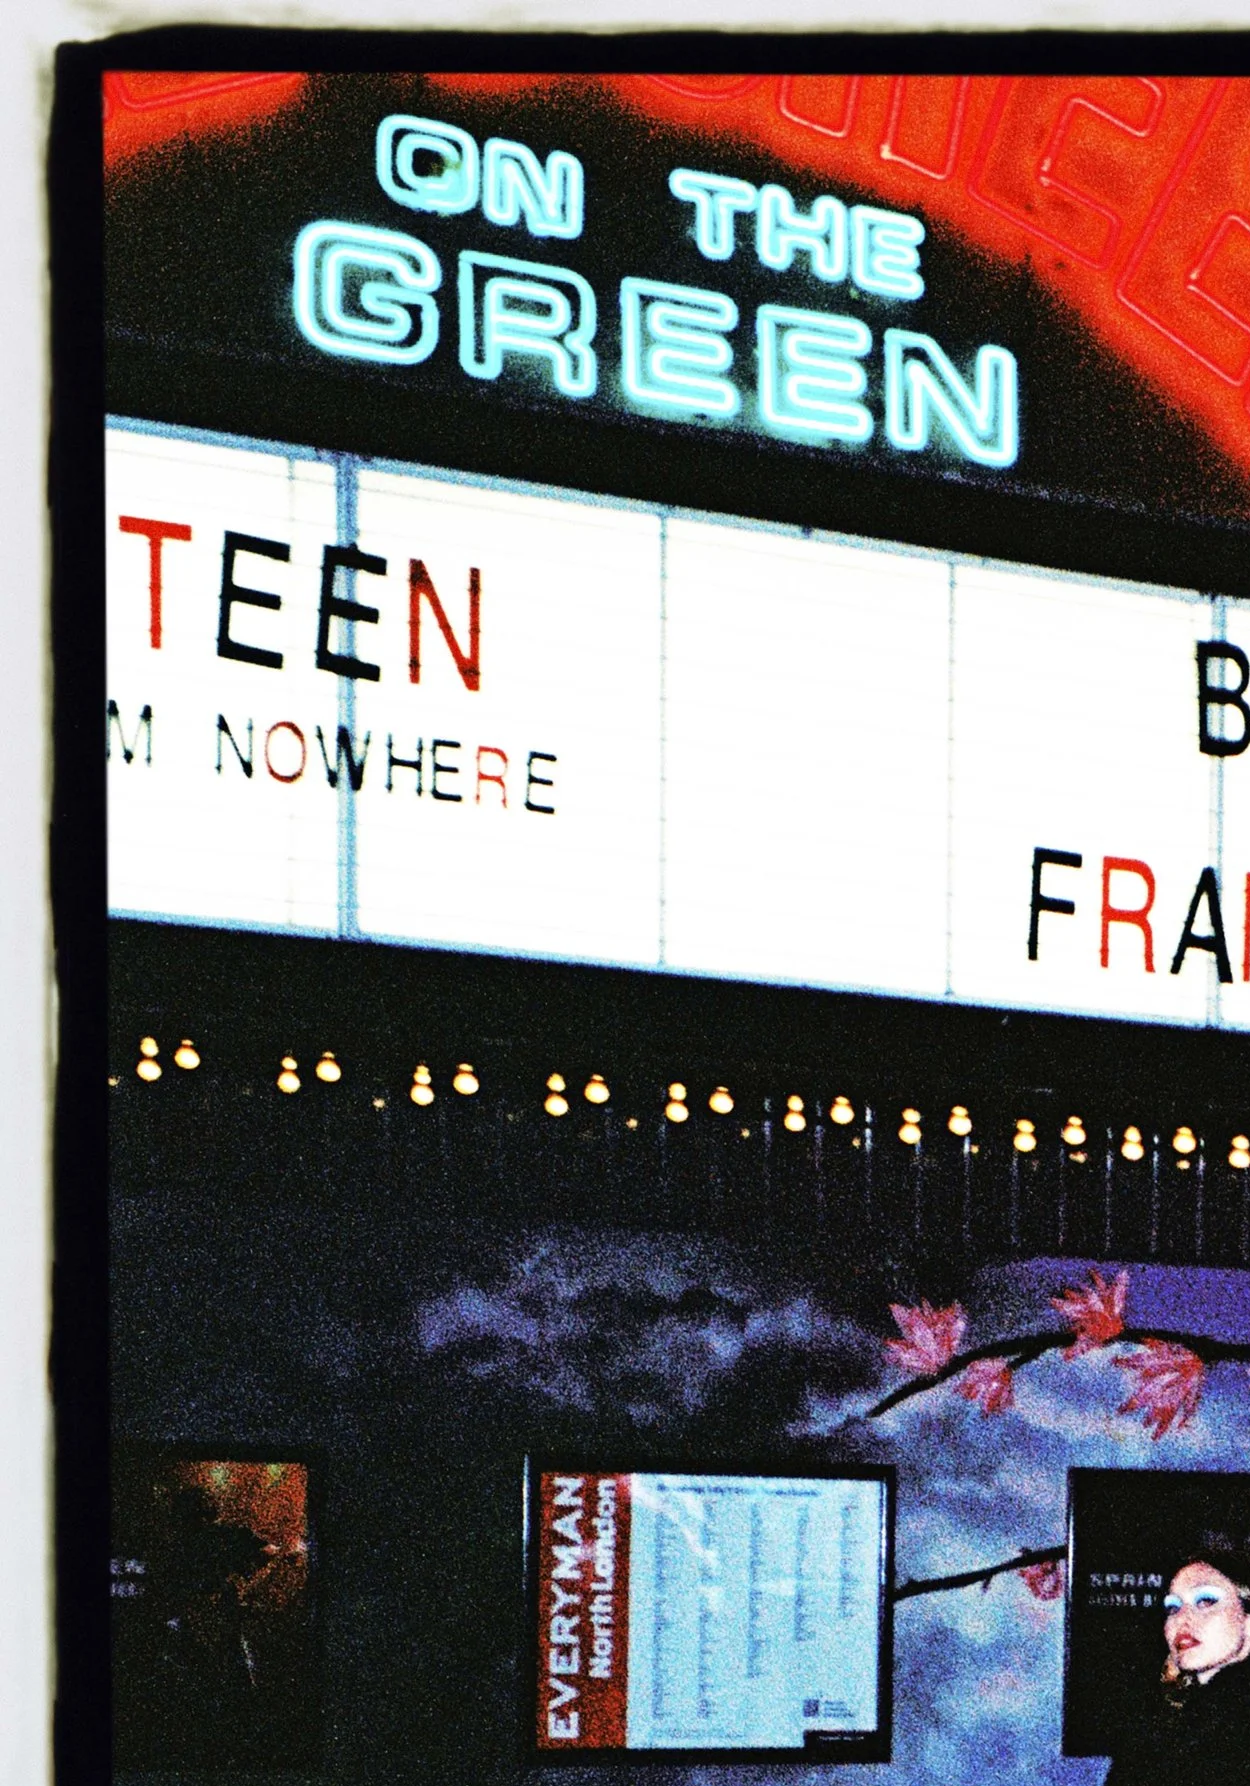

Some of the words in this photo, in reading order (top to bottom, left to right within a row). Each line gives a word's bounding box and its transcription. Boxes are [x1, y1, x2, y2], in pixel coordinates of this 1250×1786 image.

[374, 113, 585, 240] ON
[667, 167, 927, 300] THE
[292, 219, 1018, 468] GREEN
[118, 515, 481, 691] TEEN
[215, 713, 558, 814] NOWHERE
[547, 1476, 587, 1740] EVERYMAN
[593, 1479, 618, 1590] London
[589, 1594, 614, 1679] North
